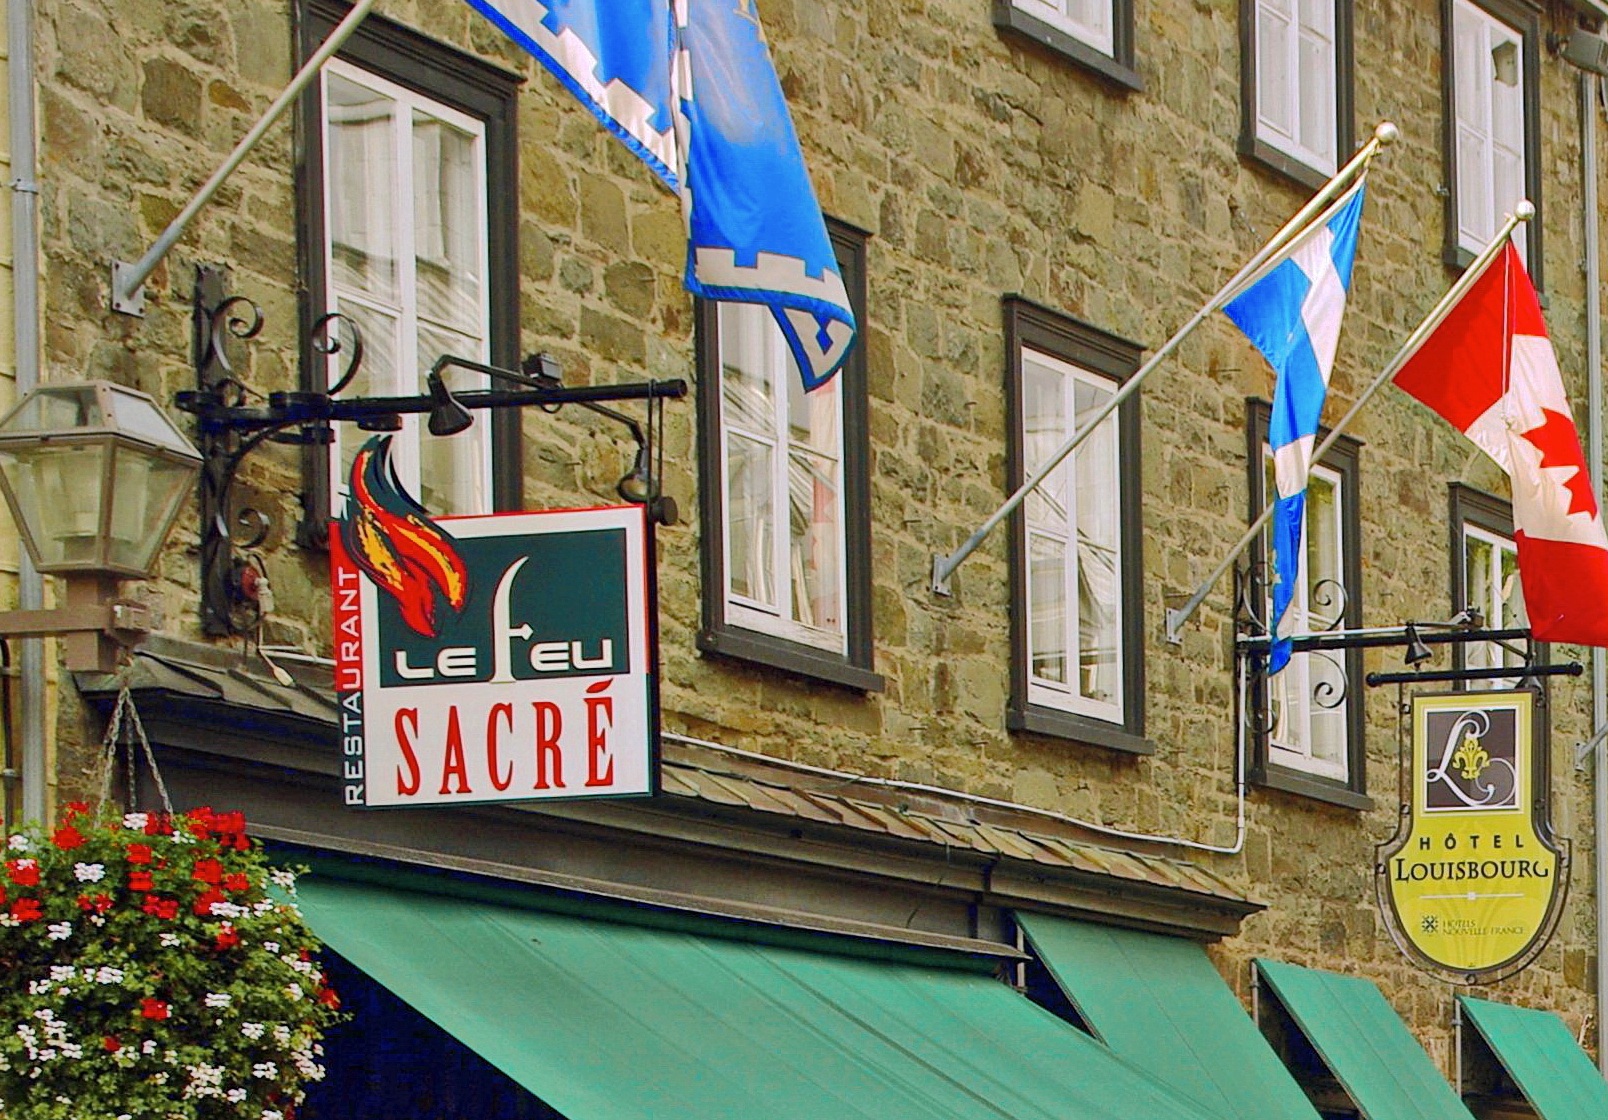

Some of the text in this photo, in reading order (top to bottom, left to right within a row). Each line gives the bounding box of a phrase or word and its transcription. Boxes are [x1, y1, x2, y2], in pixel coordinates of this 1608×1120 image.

[394, 646, 477, 680] LE
[338, 566, 365, 806] RESTAURANT
[393, 676, 615, 797] SACRÉ
[1419, 832, 1525, 851] HÔTEL
[1394, 858, 1550, 882] LOUISBOURG
[1490, 926, 1524, 935] FRANCE
